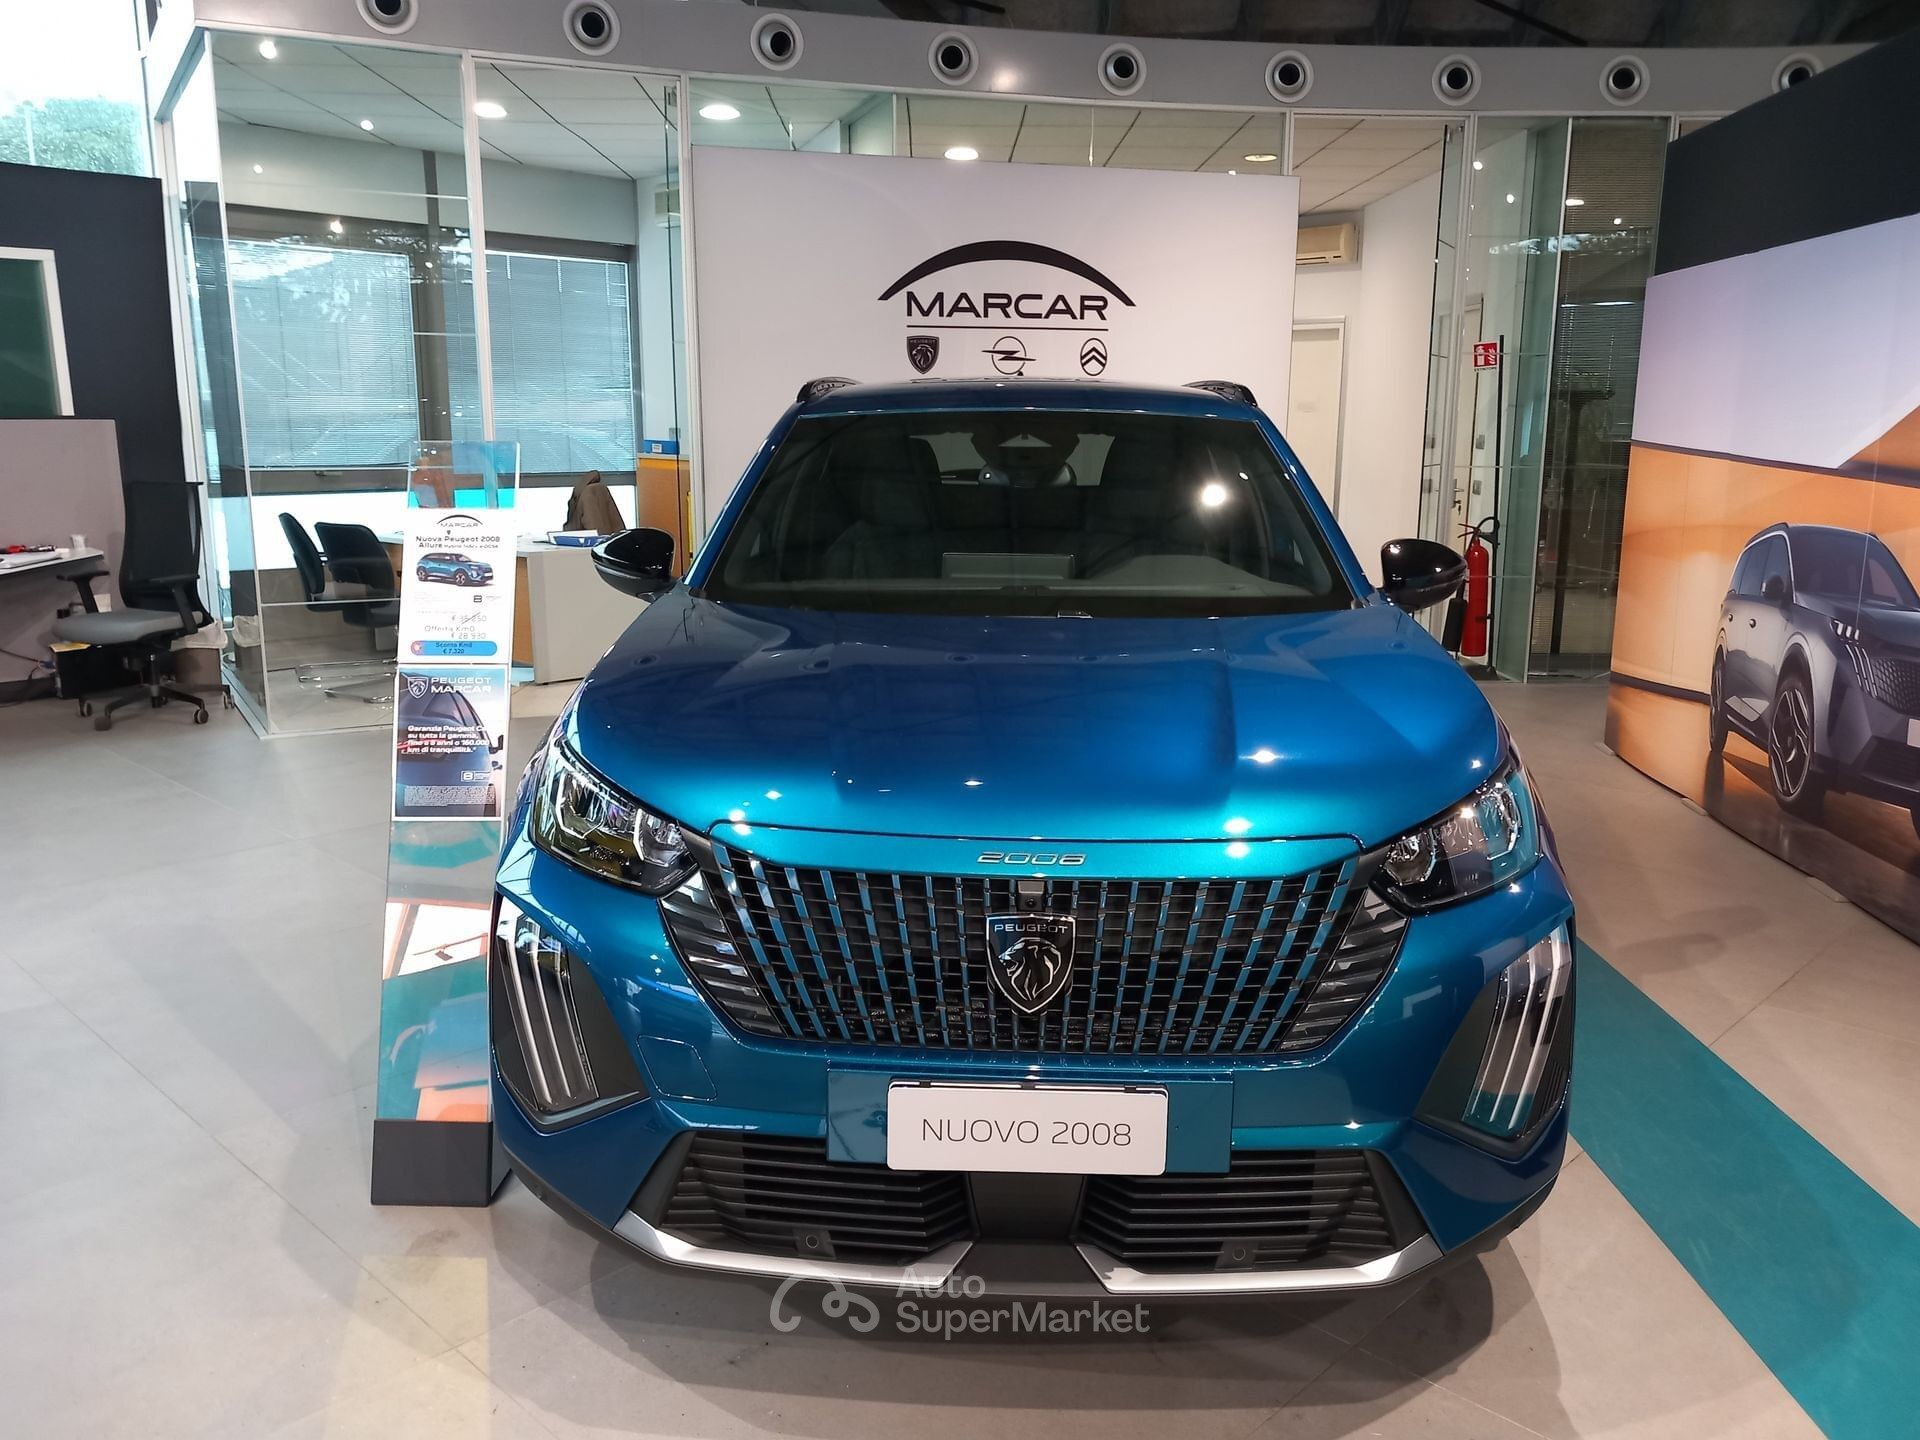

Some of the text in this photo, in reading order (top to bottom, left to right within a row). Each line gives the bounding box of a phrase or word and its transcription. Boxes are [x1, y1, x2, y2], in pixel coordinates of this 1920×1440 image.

[907, 290, 1109, 321] MARCAR
[444, 535, 479, 543] Peugeot
[430, 685, 492, 694] MARCAR
[977, 851, 1087, 866] 2008
[994, 923, 1069, 934] PEUGEOT
[921, 1118, 1132, 1147] NUOVO 2008
